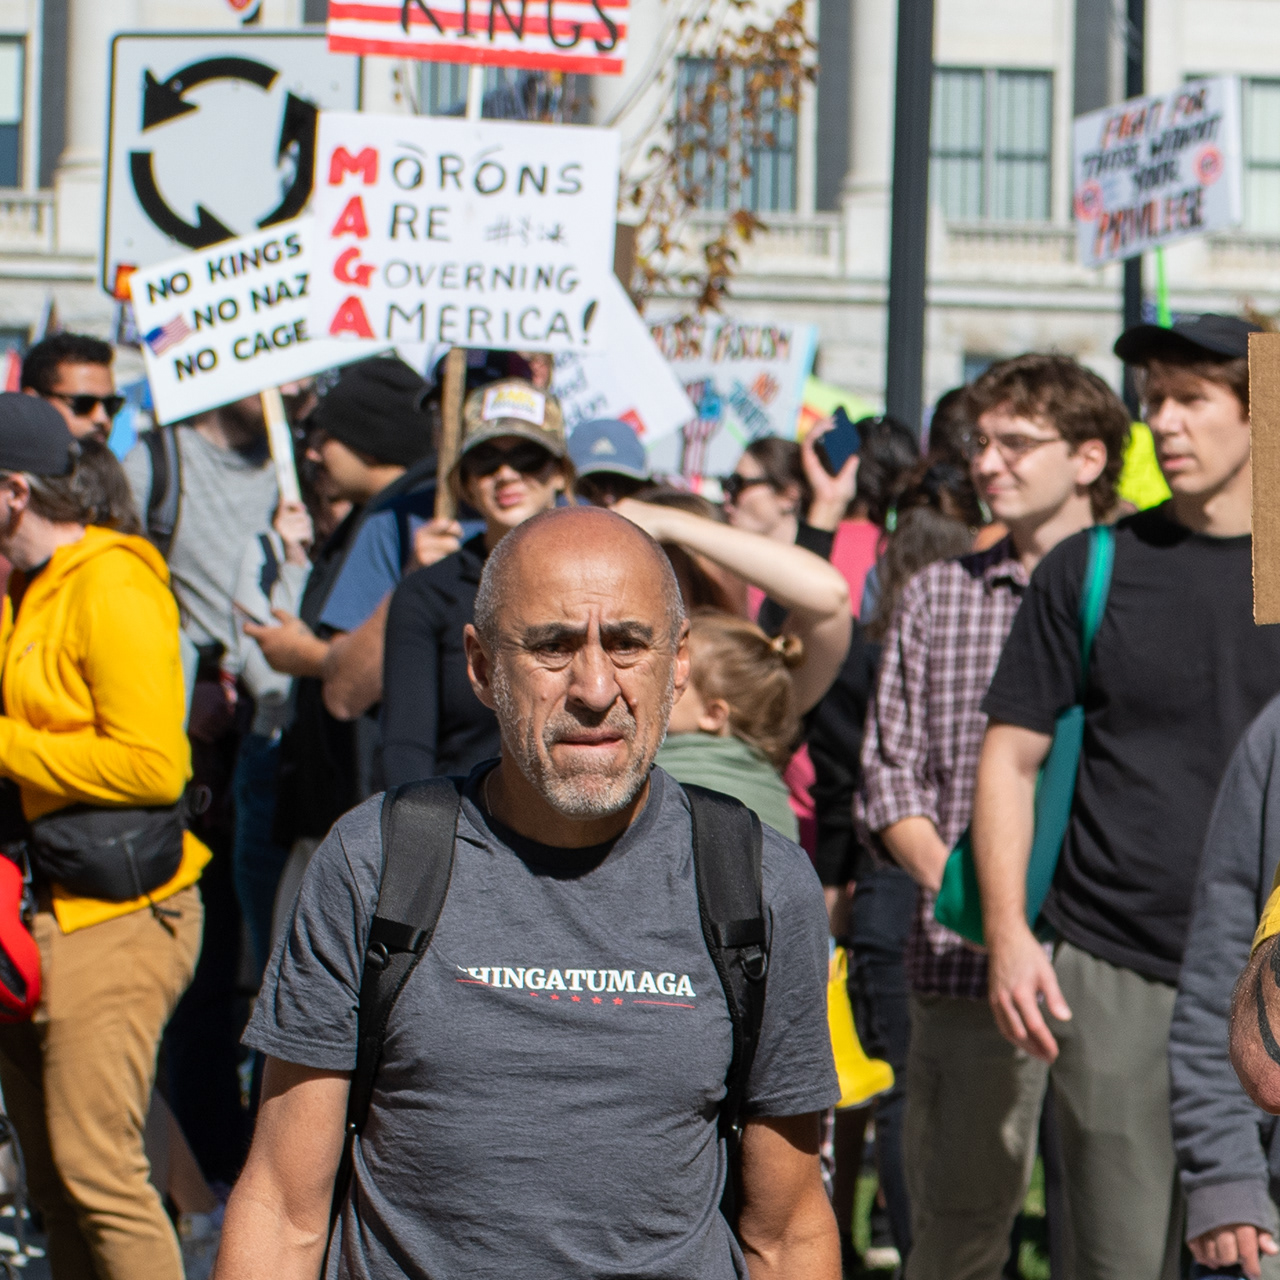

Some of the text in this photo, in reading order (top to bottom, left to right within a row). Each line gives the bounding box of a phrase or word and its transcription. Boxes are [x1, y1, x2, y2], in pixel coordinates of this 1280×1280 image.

[328, 146, 583, 195] MORONS
[331, 196, 451, 242] ARE
[147, 233, 302, 304] NO KINGS
[333, 247, 581, 294] GOVERNING
[193, 298, 239, 331] NO
[329, 296, 598, 345] AMERICA!
[174, 348, 218, 381] NO
[457, 964, 696, 998] HINGATUMAGA
